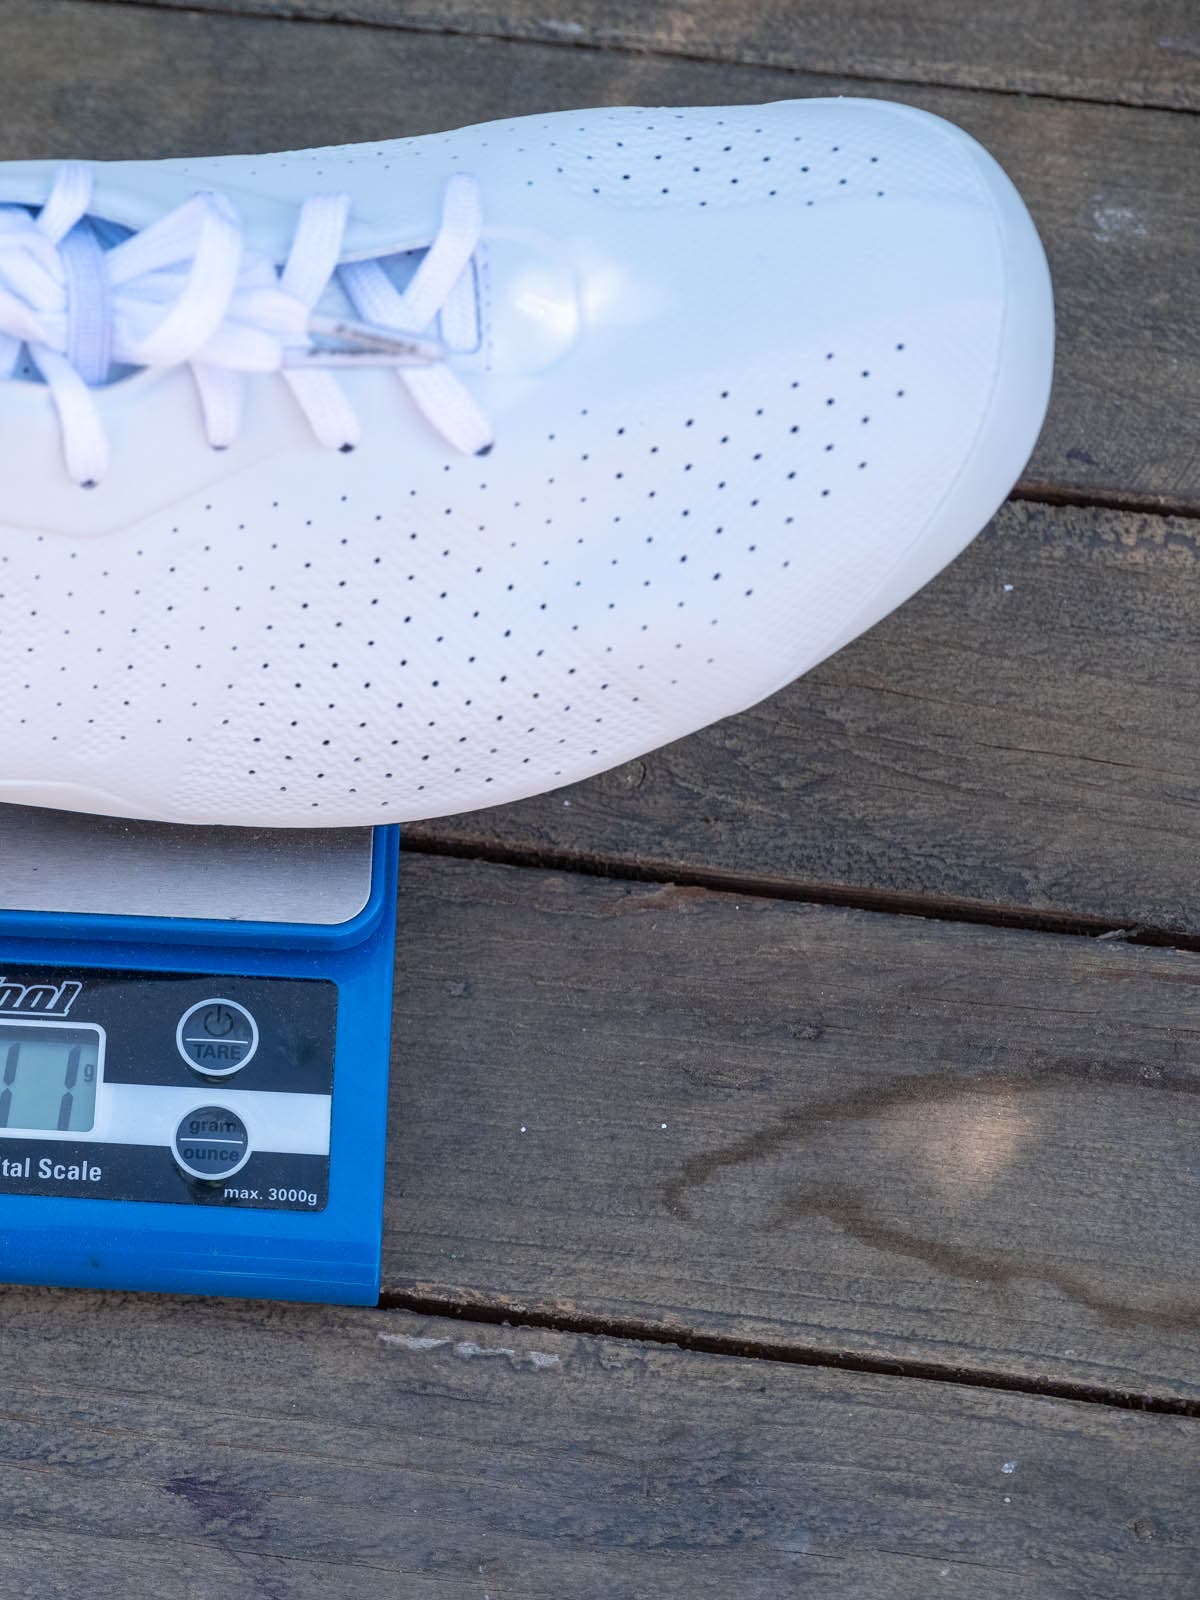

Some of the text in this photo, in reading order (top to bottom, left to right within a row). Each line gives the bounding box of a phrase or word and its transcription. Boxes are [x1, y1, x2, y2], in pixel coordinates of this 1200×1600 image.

[193, 1043, 241, 1059] TARE
[189, 1120, 237, 1134] gram
[183, 1149, 239, 1161] ounce
[38, 1158, 102, 1182] Scale
[224, 1188, 318, 1206] max. 3000g
